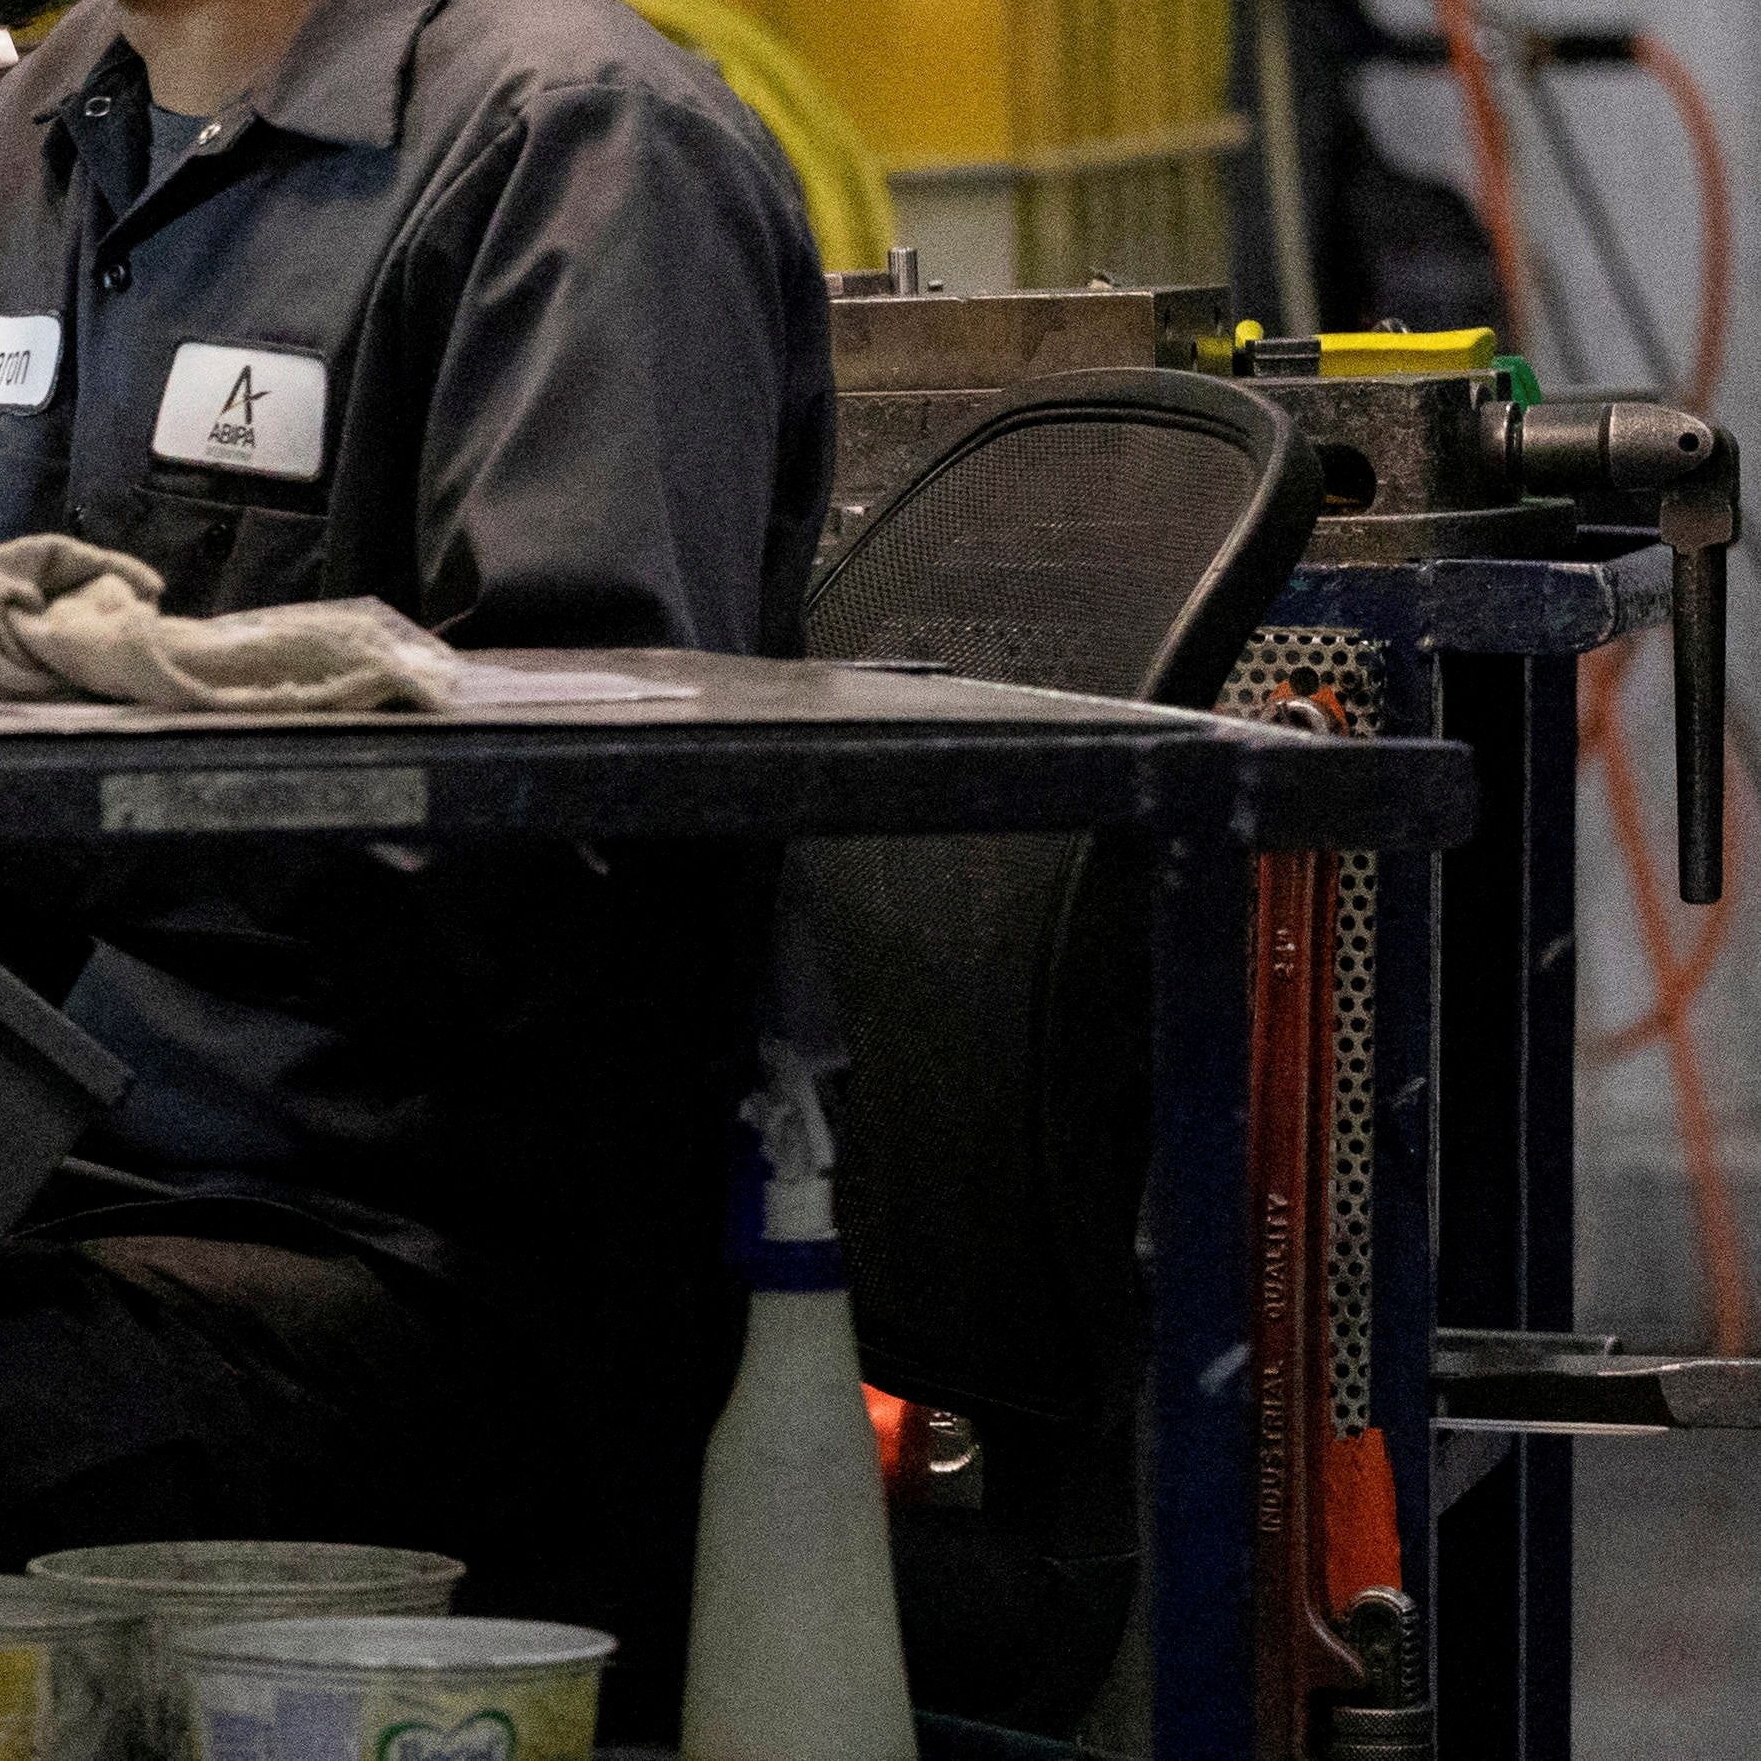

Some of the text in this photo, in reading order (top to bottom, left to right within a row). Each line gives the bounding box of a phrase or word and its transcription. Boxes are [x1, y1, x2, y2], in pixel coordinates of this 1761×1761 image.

[207, 422, 256, 449] ABIPA
[1260, 1192, 1289, 1533] INDUSTRIAL QUALITY
